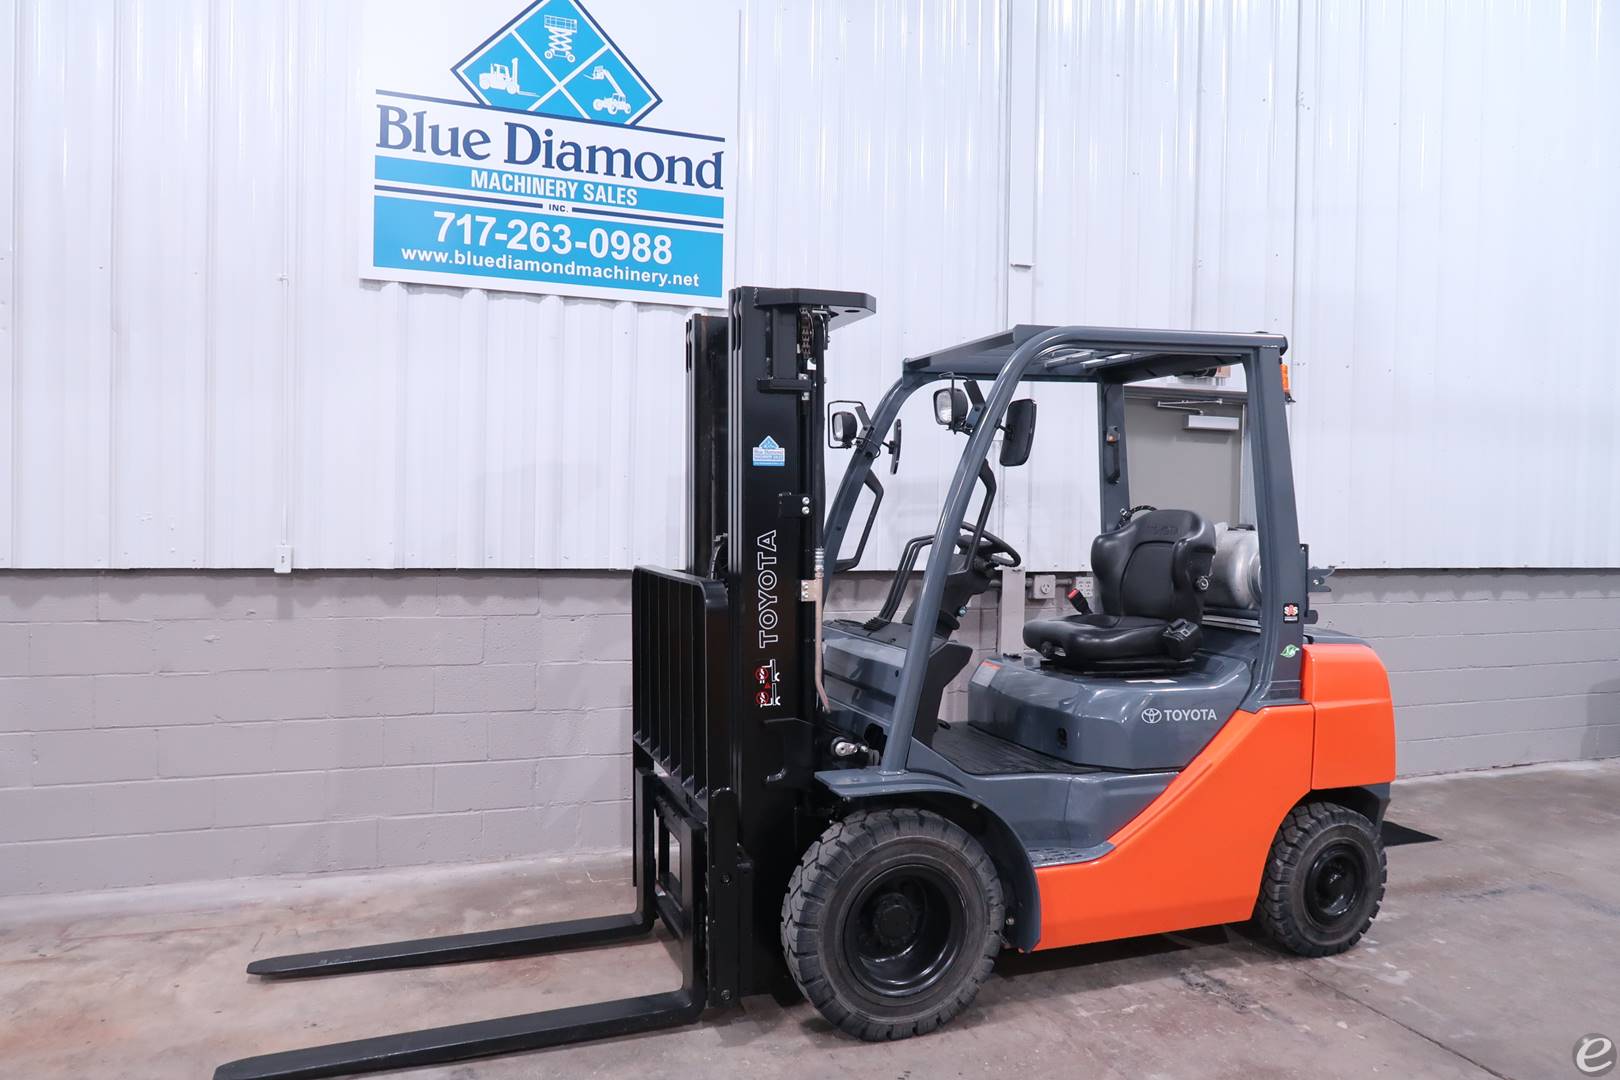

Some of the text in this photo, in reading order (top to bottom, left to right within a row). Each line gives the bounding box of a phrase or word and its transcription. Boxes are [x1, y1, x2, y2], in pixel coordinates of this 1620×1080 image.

[376, 104, 724, 190] Blue Diamond
[470, 170, 638, 206] MACHINERY SALES
[548, 204, 569, 213] INC.
[433, 211, 672, 265] 717-263-0988
[401, 247, 700, 287] www.bluediamondmachinery.net
[757, 530, 778, 649] TOYOTA
[1164, 708, 1217, 722] TOYOTA
